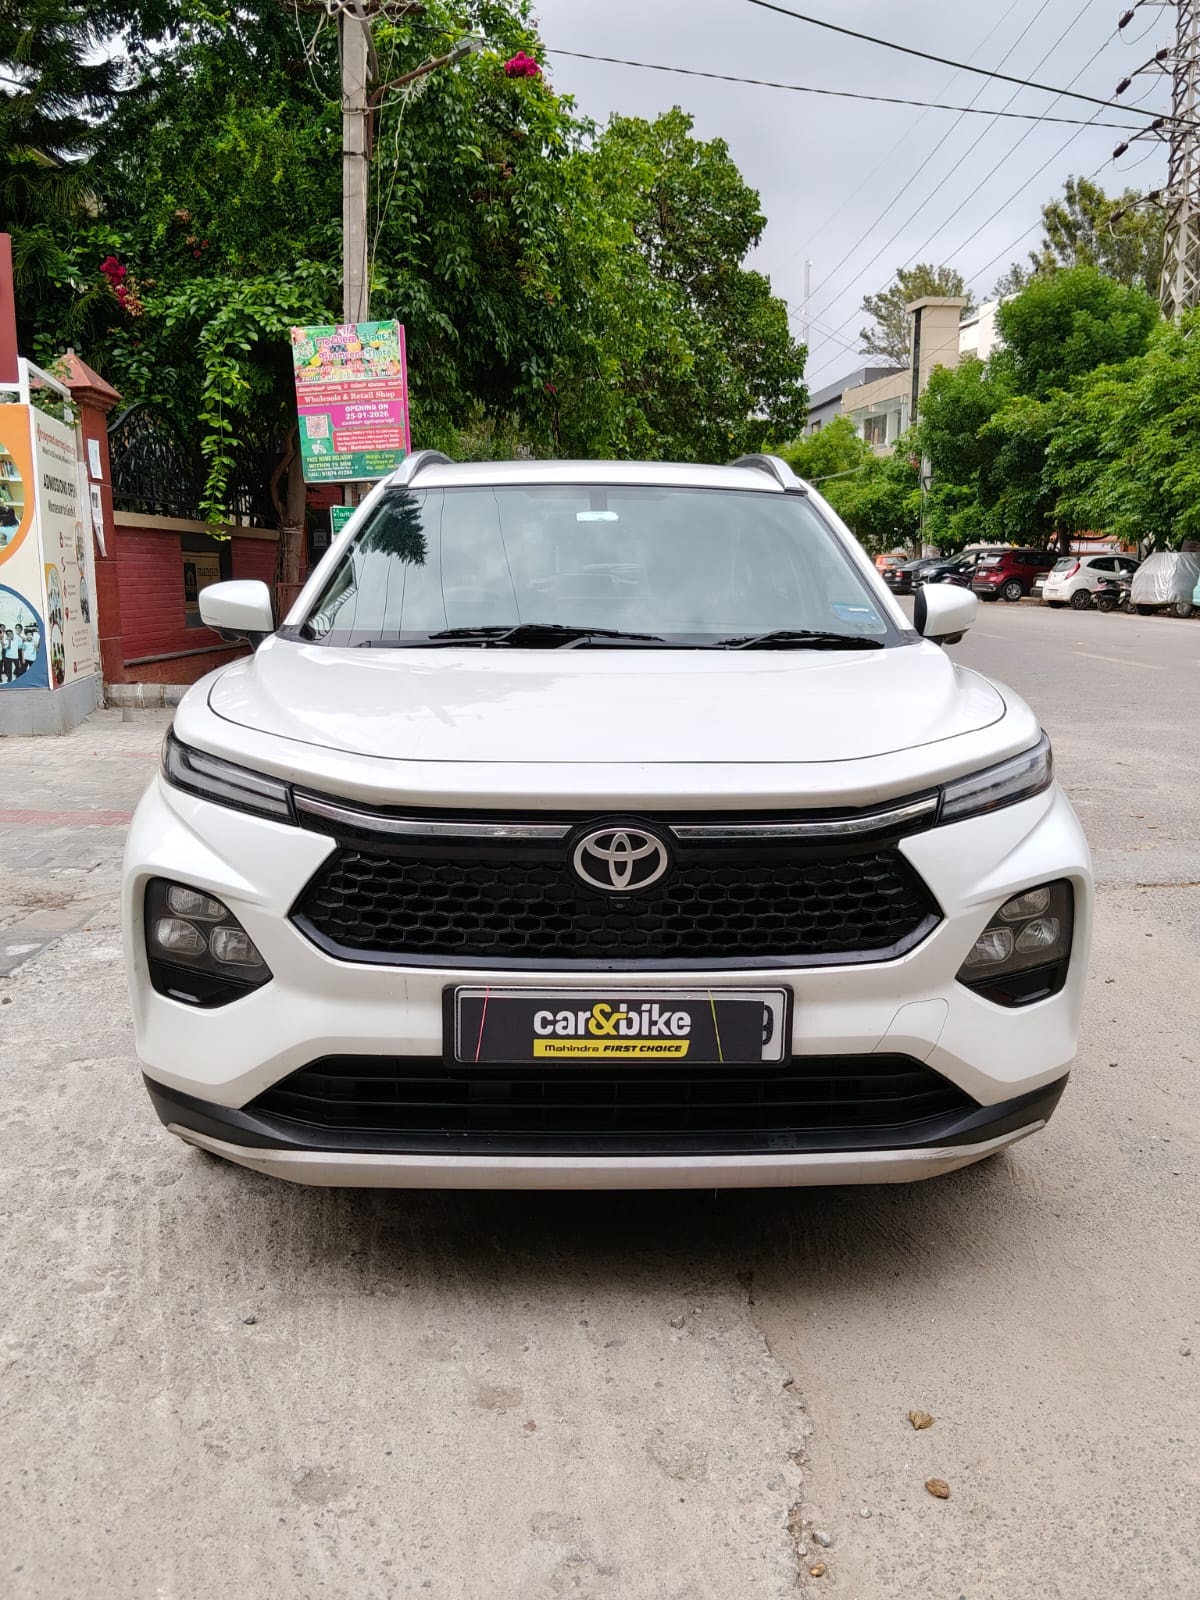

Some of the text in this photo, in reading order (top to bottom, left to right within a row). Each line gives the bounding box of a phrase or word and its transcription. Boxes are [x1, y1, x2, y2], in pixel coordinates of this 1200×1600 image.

[304, 394, 341, 402] Wholesale
[534, 1003, 691, 1036] car&bike
[544, 1044, 600, 1052] Mahindra
